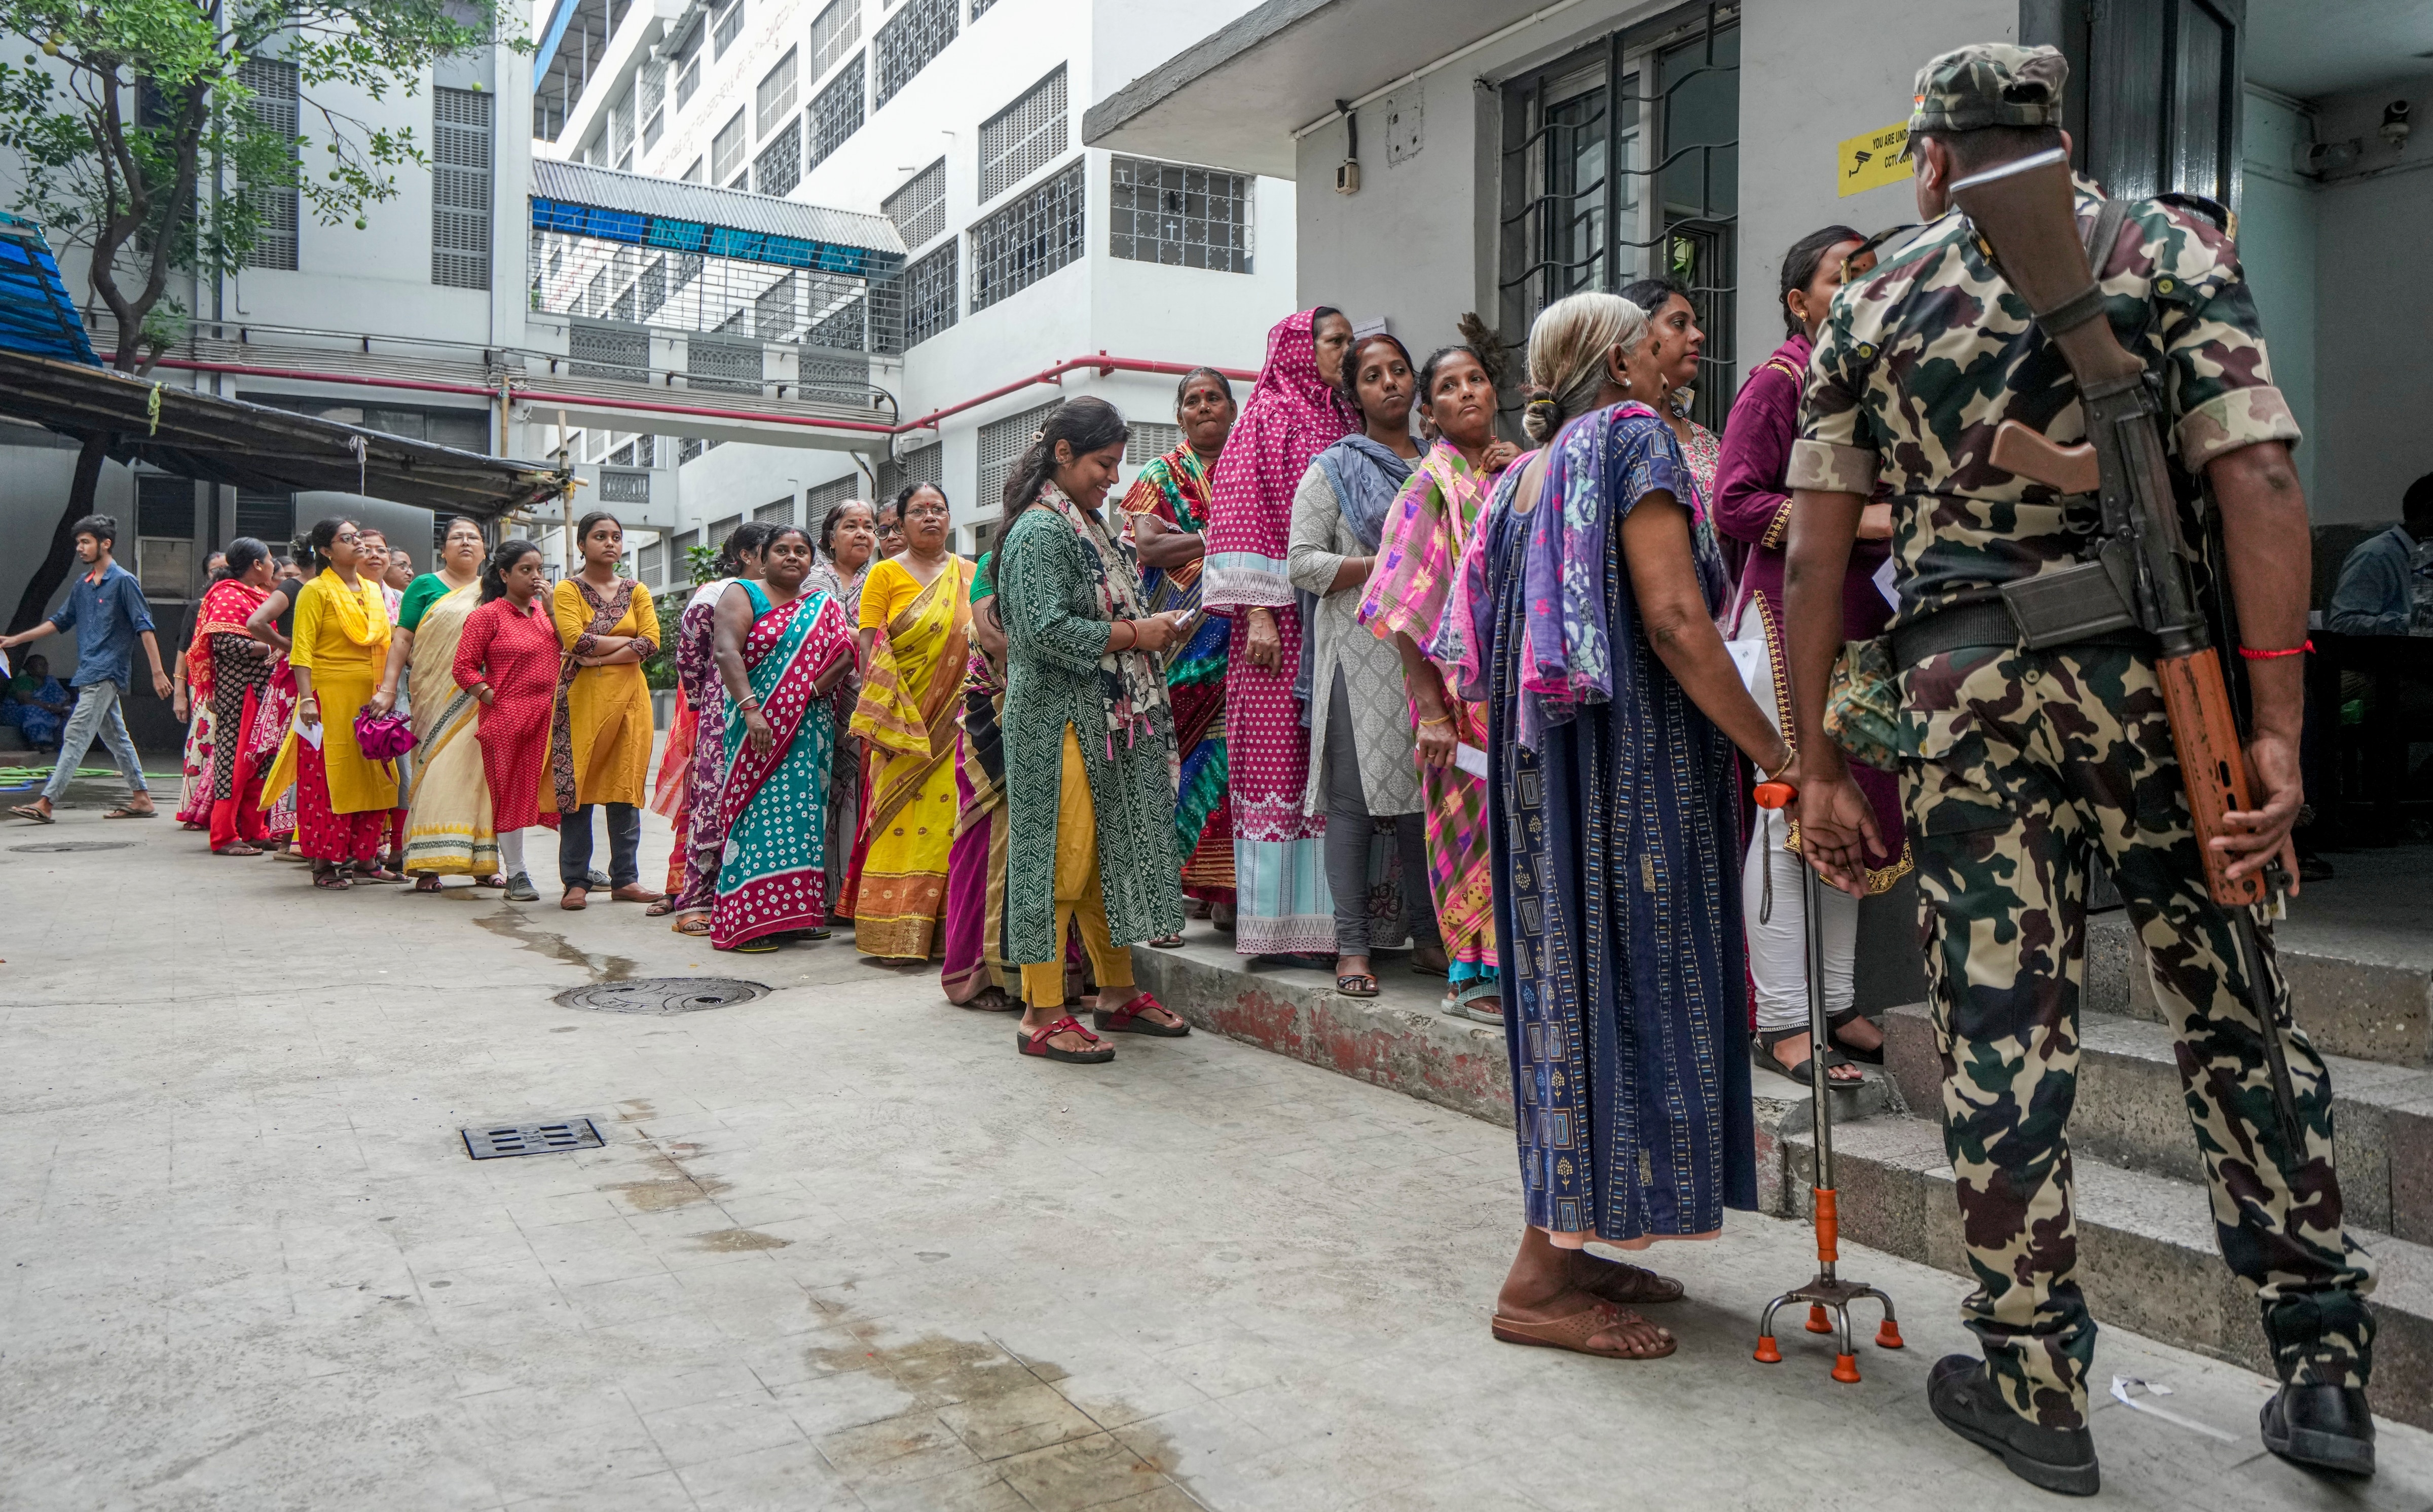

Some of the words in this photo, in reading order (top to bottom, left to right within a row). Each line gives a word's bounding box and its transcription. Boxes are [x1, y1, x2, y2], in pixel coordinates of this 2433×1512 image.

[1873, 136, 1883, 151] YOU
[1884, 132, 1895, 147] ARE
[1896, 129, 1909, 143] UNDE
[1885, 153, 1899, 169] CCTV
